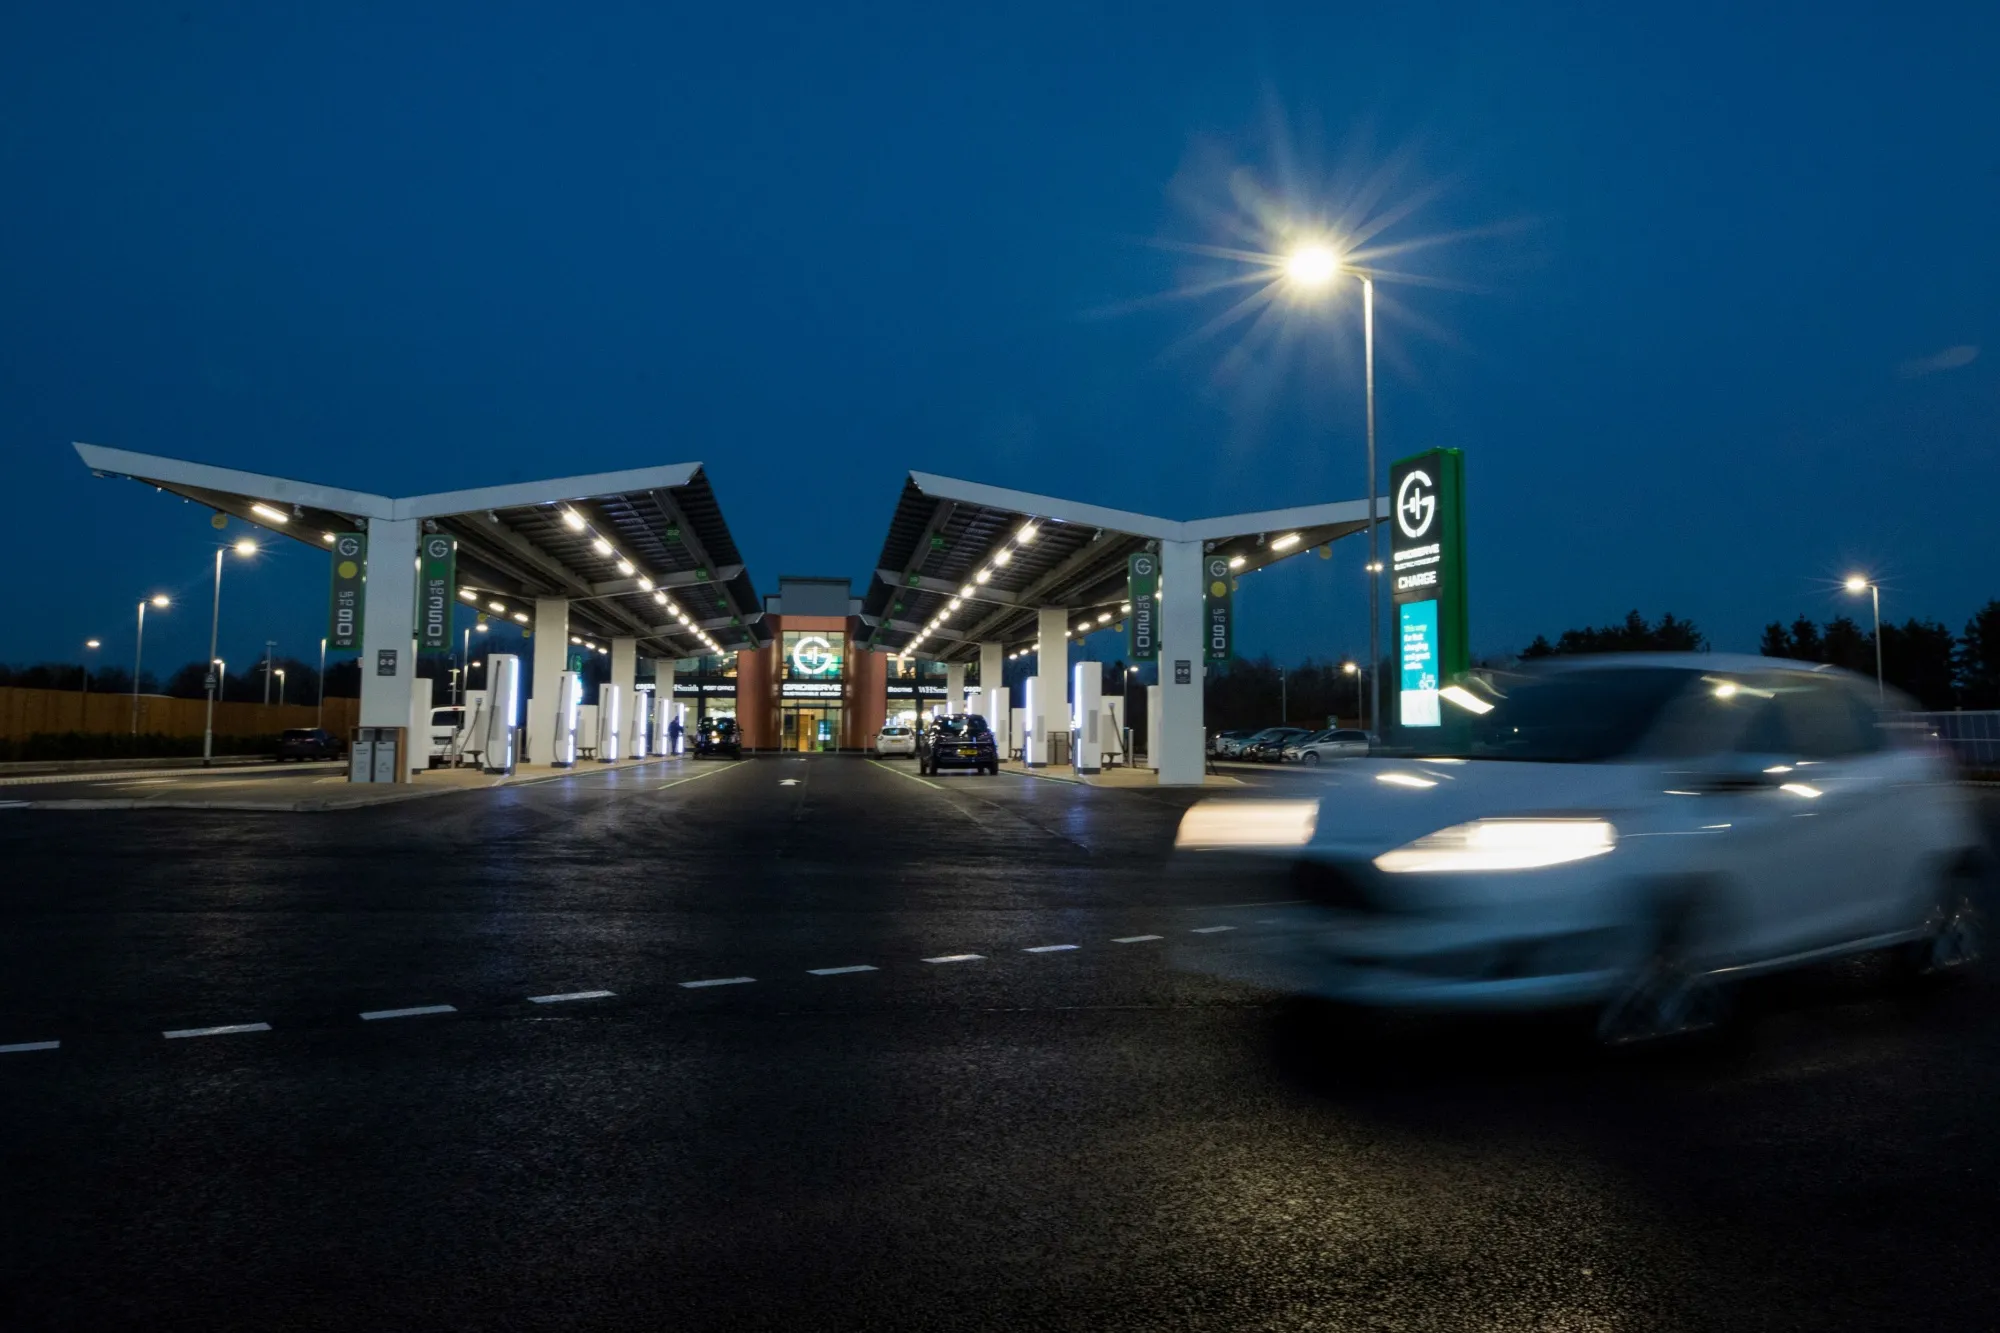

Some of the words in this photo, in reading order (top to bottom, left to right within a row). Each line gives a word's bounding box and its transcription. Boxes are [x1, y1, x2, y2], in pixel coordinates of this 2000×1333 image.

[429, 579, 445, 587] UP
[1398, 570, 1437, 589] CHARGE
[336, 608, 354, 636] 90
[427, 596, 444, 637] 350
[1212, 615, 1226, 623] TO
[1136, 610, 1150, 648] 350
[1212, 624, 1226, 649] 90
[782, 683, 842, 691] GRIDSERVE
